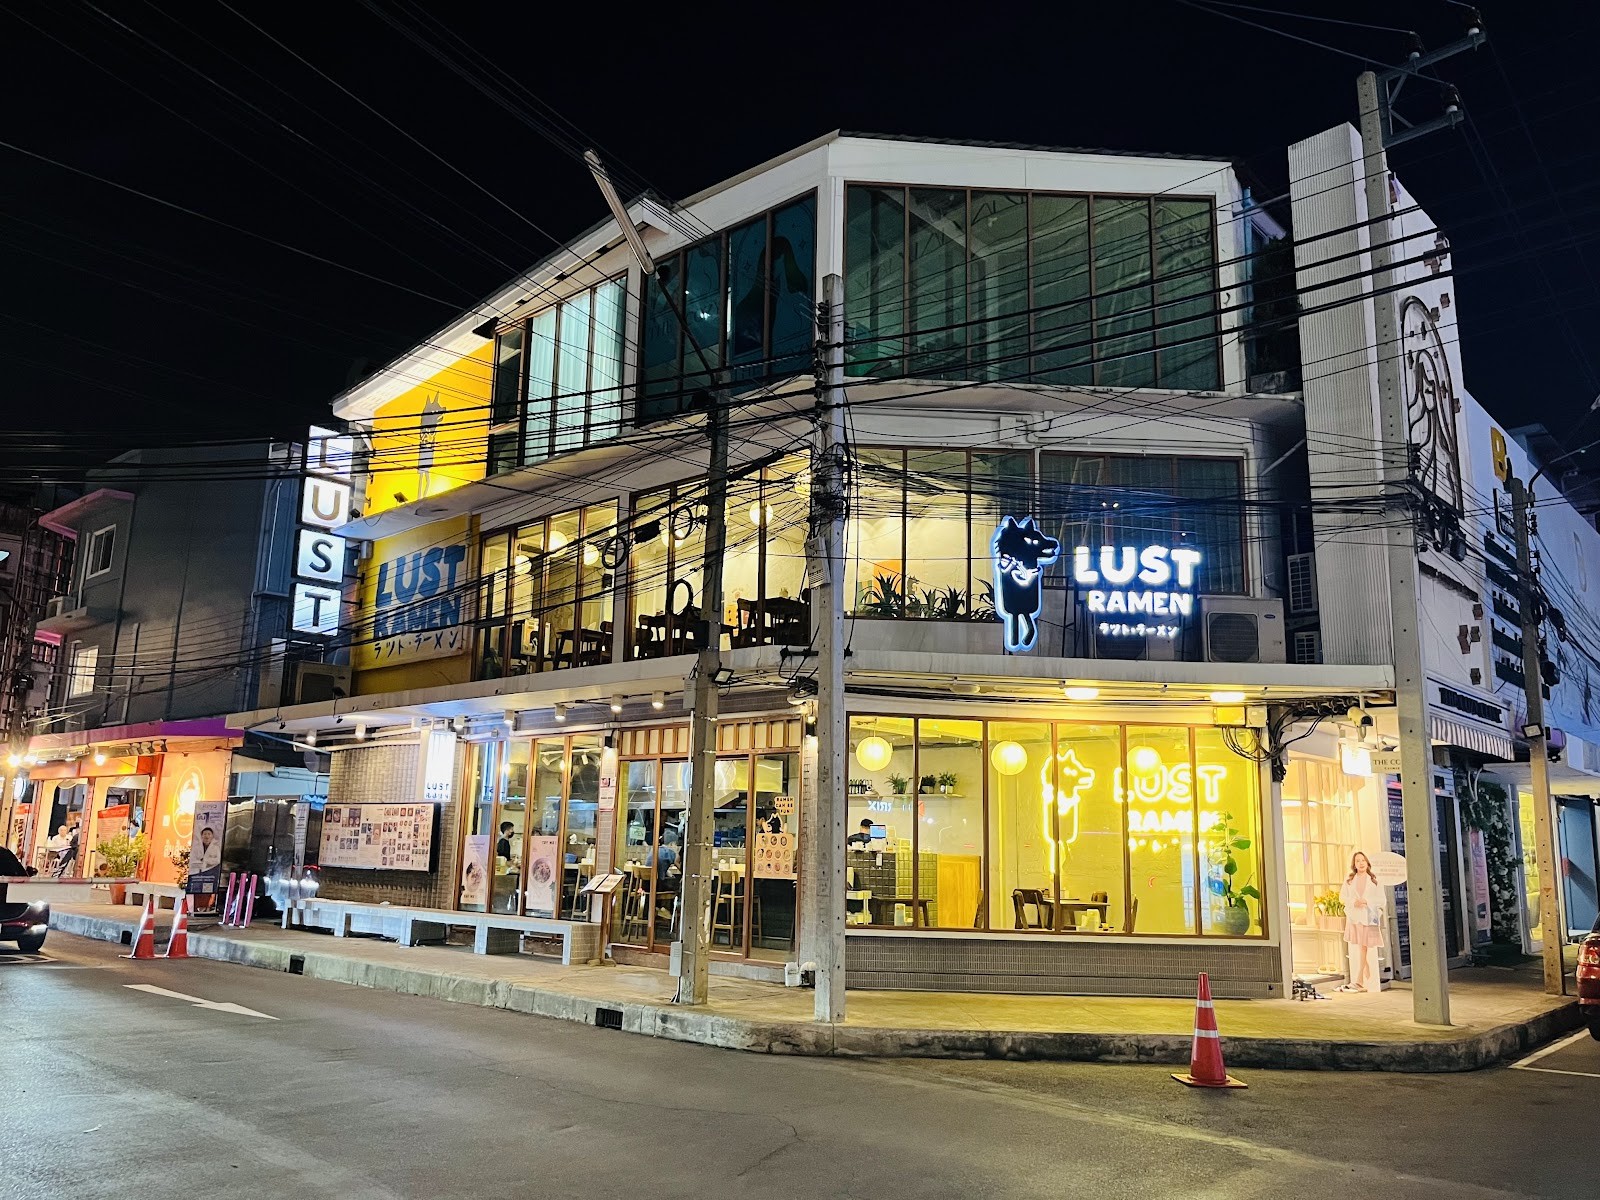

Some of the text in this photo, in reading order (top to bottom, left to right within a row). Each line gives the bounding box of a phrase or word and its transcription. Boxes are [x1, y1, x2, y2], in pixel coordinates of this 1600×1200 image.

[304, 436, 341, 628] LUST
[375, 545, 465, 608] LUST
[1075, 545, 1202, 588] LUST
[373, 594, 461, 639] RAMEN
[1087, 590, 1193, 616] RAMEN
[426, 782, 449, 790] LUST
[1113, 763, 1228, 804] LUST
